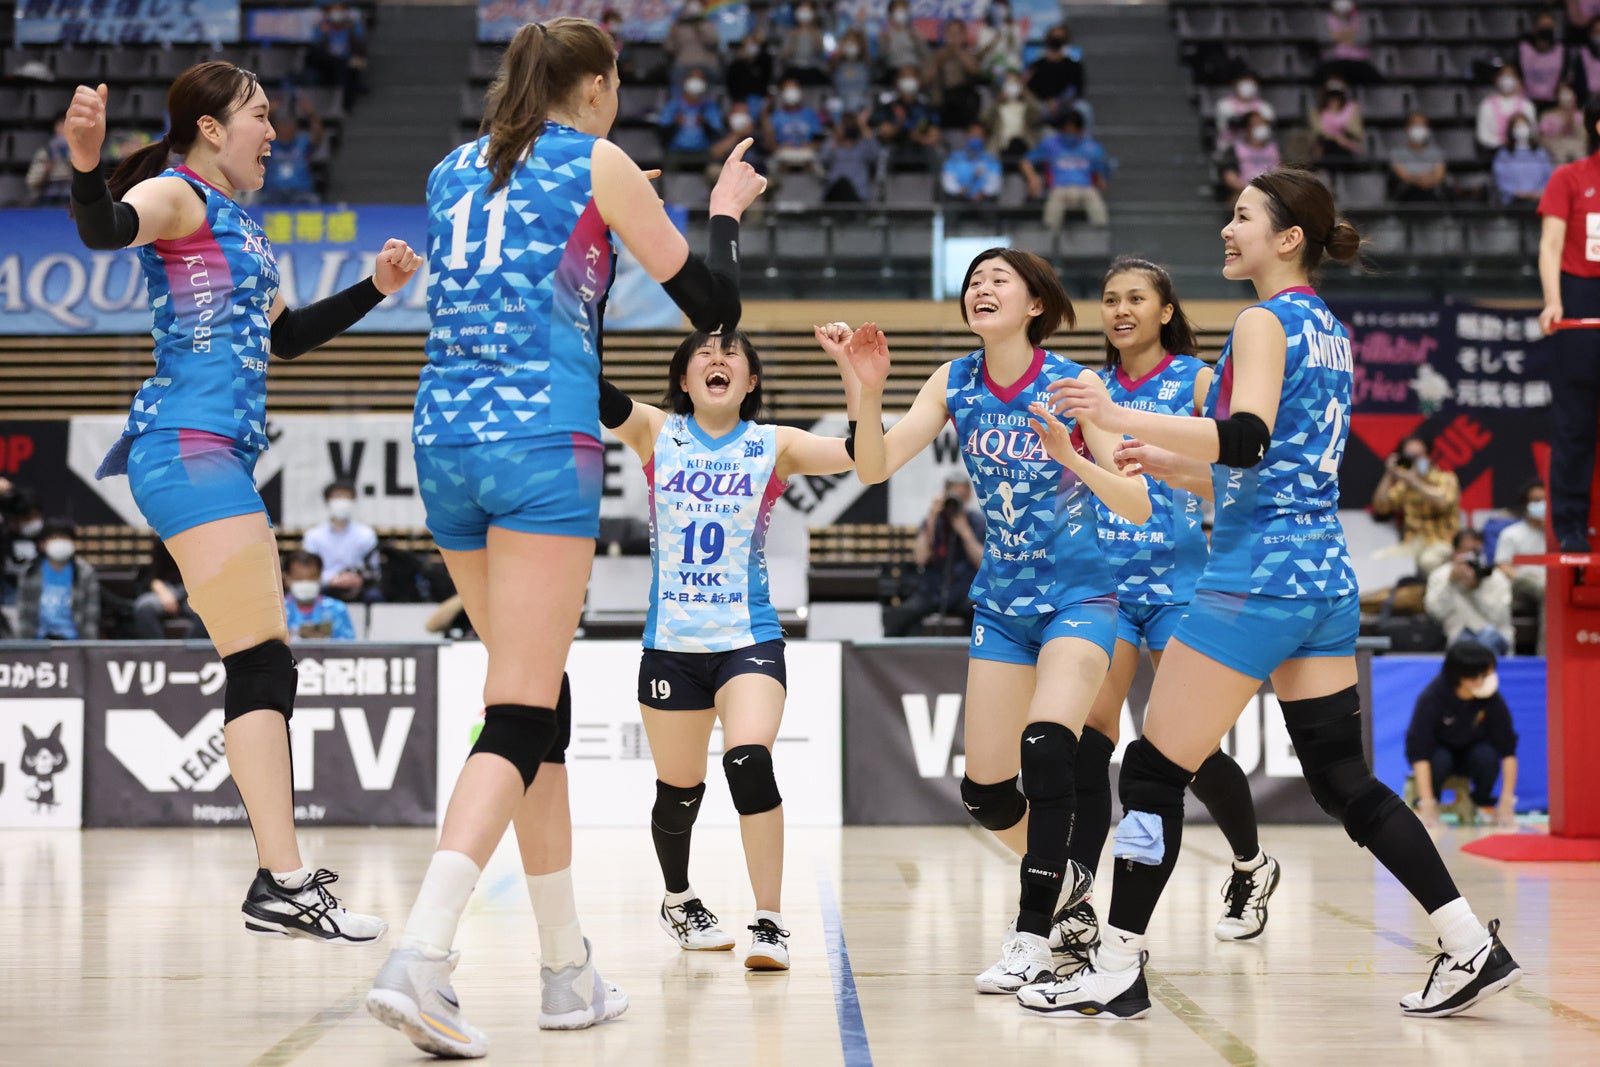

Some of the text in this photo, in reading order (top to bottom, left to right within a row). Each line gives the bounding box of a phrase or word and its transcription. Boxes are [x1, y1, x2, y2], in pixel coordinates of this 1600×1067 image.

[447, 186, 512, 271] 11
[182, 254, 214, 353] KUROBE
[1162, 380, 1181, 388] YKK
[980, 413, 1032, 428] KUROB
[1318, 397, 1343, 473] 2
[965, 427, 1052, 466] AQUA
[686, 459, 741, 471] KUROBE
[976, 464, 1039, 481] FAIRIES
[661, 470, 754, 502] AQUA
[676, 502, 742, 514] FAIRIES
[998, 481, 1016, 527] 8
[681, 520, 725, 565] 19
[998, 526, 1031, 547] YKK
[678, 571, 722, 587] YKK
[662, 590, 743, 604] 北日本新聞
[974, 625, 985, 647] 8
[650, 678, 671, 700] 19
[288, 707, 415, 791] TV
